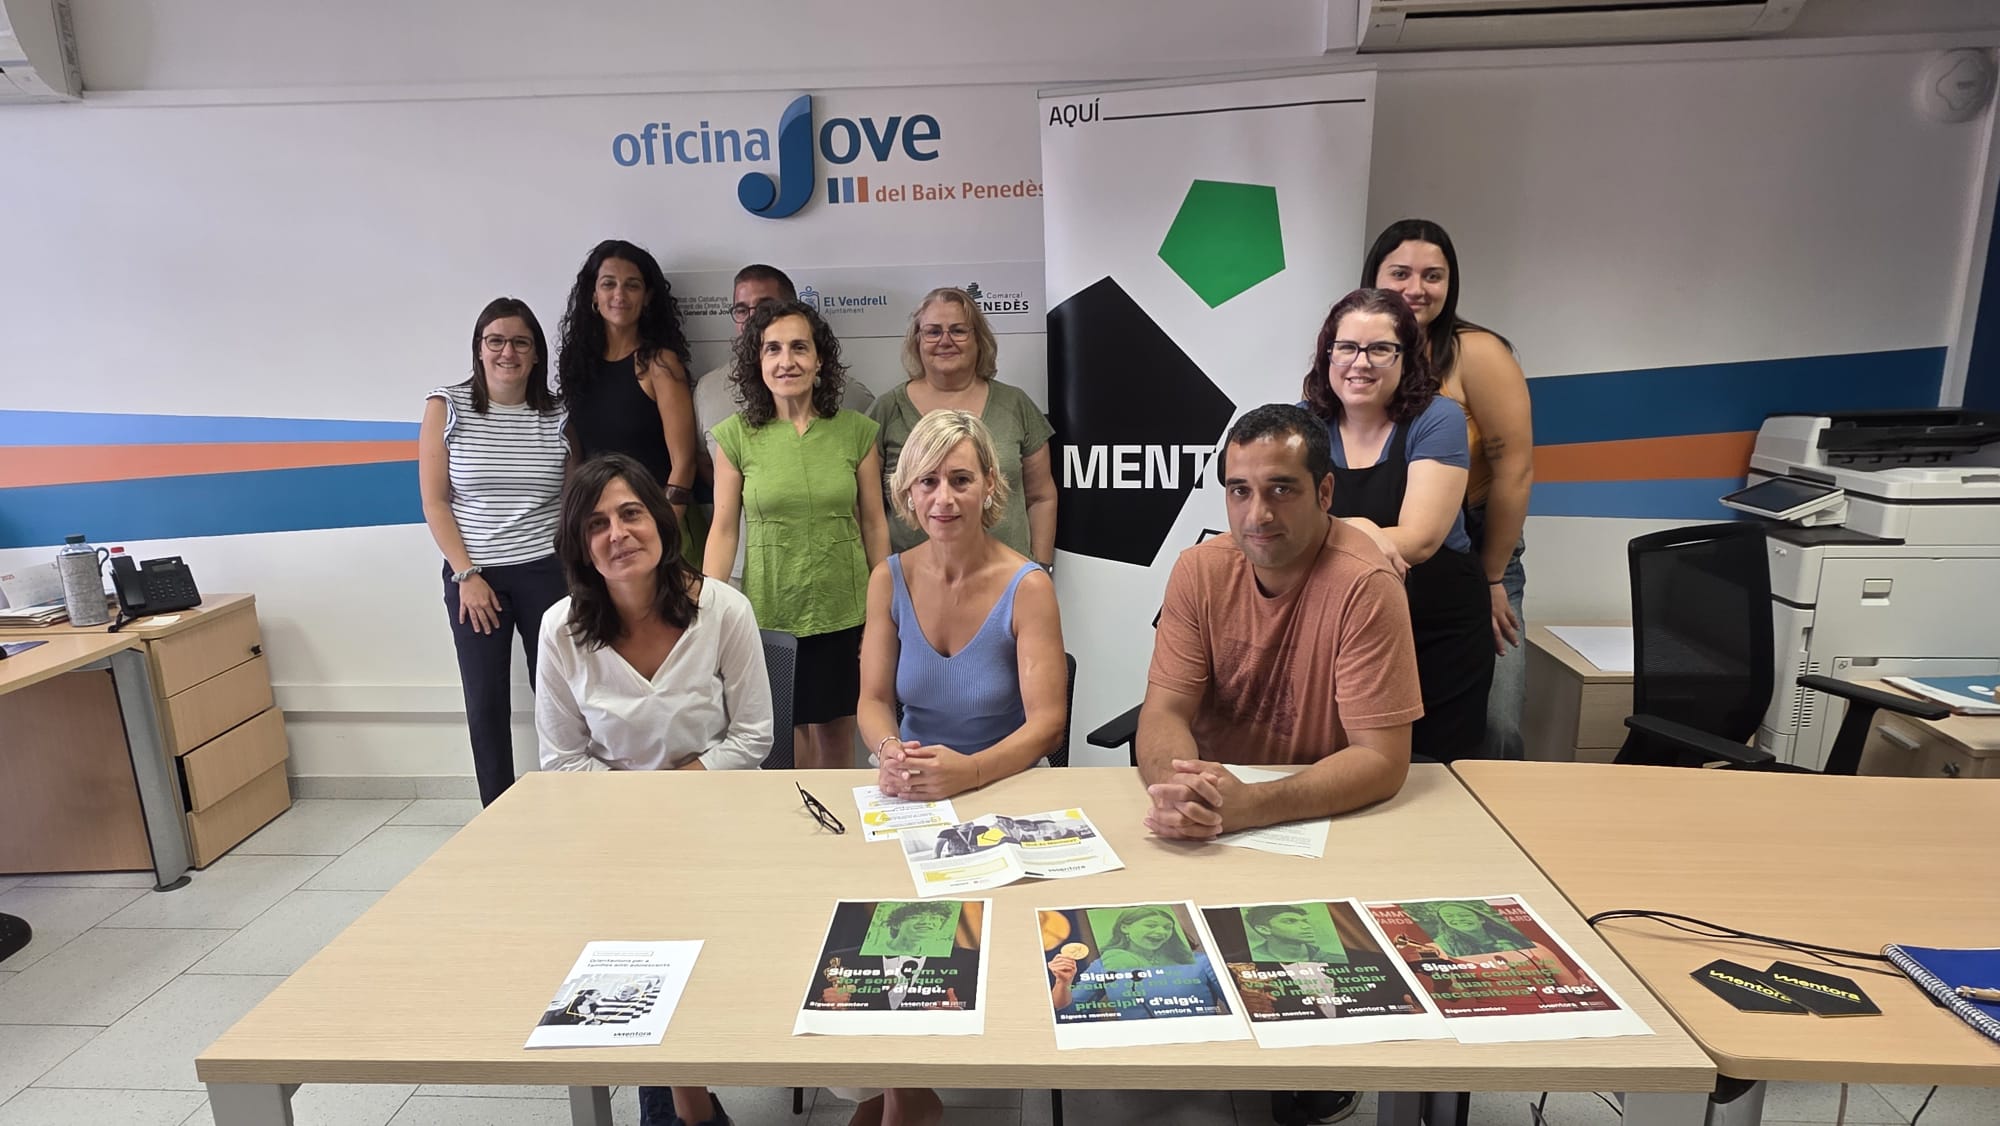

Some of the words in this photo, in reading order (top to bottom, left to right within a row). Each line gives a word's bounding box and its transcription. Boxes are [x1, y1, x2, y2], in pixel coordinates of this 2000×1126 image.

[1049, 97, 1100, 127] AQUÍ
[612, 121, 771, 166] oficina
[738, 94, 941, 219] Jove
[875, 184, 906, 202] del
[912, 183, 956, 201] Baix
[986, 291, 1023, 299] Comarcal
[824, 297, 835, 307] El
[838, 296, 887, 306] Vendrell
[825, 307, 864, 316] Ajuntament
[828, 968, 880, 977] Sigues
[885, 967, 898, 976] el
[1241, 968, 1296, 979] Sigues
[1300, 967, 1315, 976] el
[1355, 965, 1379, 973] em
[1421, 962, 1477, 972] Sigues
[1480, 961, 1493, 969] el
[865, 977, 912, 985] sentir
[916, 978, 944, 986] que
[1080, 972, 1134, 982] Sigues
[1137, 971, 1152, 979] el
[1268, 977, 1318, 988] ajudar
[1324, 977, 1334, 985] a
[1337, 974, 1387, 983] trobar
[1431, 971, 1477, 981] donar
[1451, 981, 1492, 990] quan
[1534, 977, 1556, 985] ho
[1270, 988, 1287, 997] el
